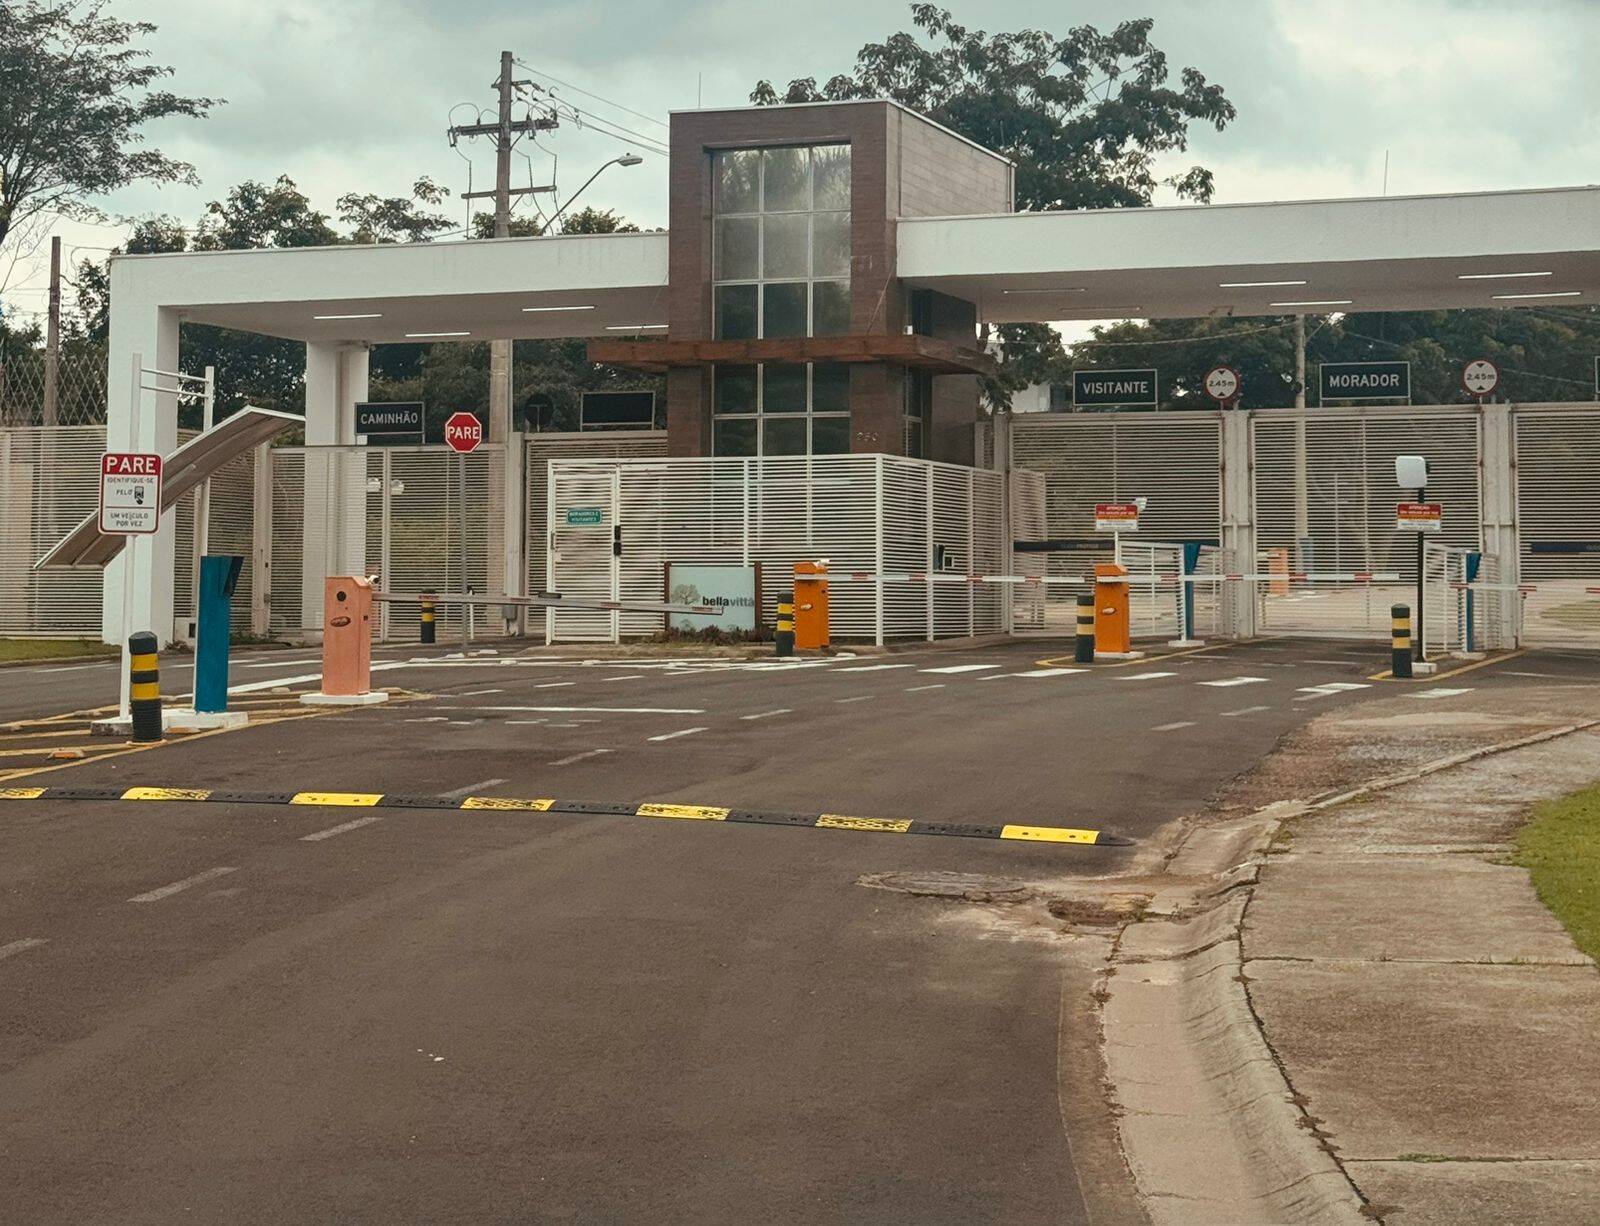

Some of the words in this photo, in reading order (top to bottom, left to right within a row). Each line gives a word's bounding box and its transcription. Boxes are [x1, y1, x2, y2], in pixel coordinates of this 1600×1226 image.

[1328, 373, 1400, 388] MORADOR
[1082, 381, 1149, 395] VISITANTE
[360, 410, 418, 424] CAMINHÃO
[447, 426, 480, 440] PARE
[106, 456, 156, 473] PARE
